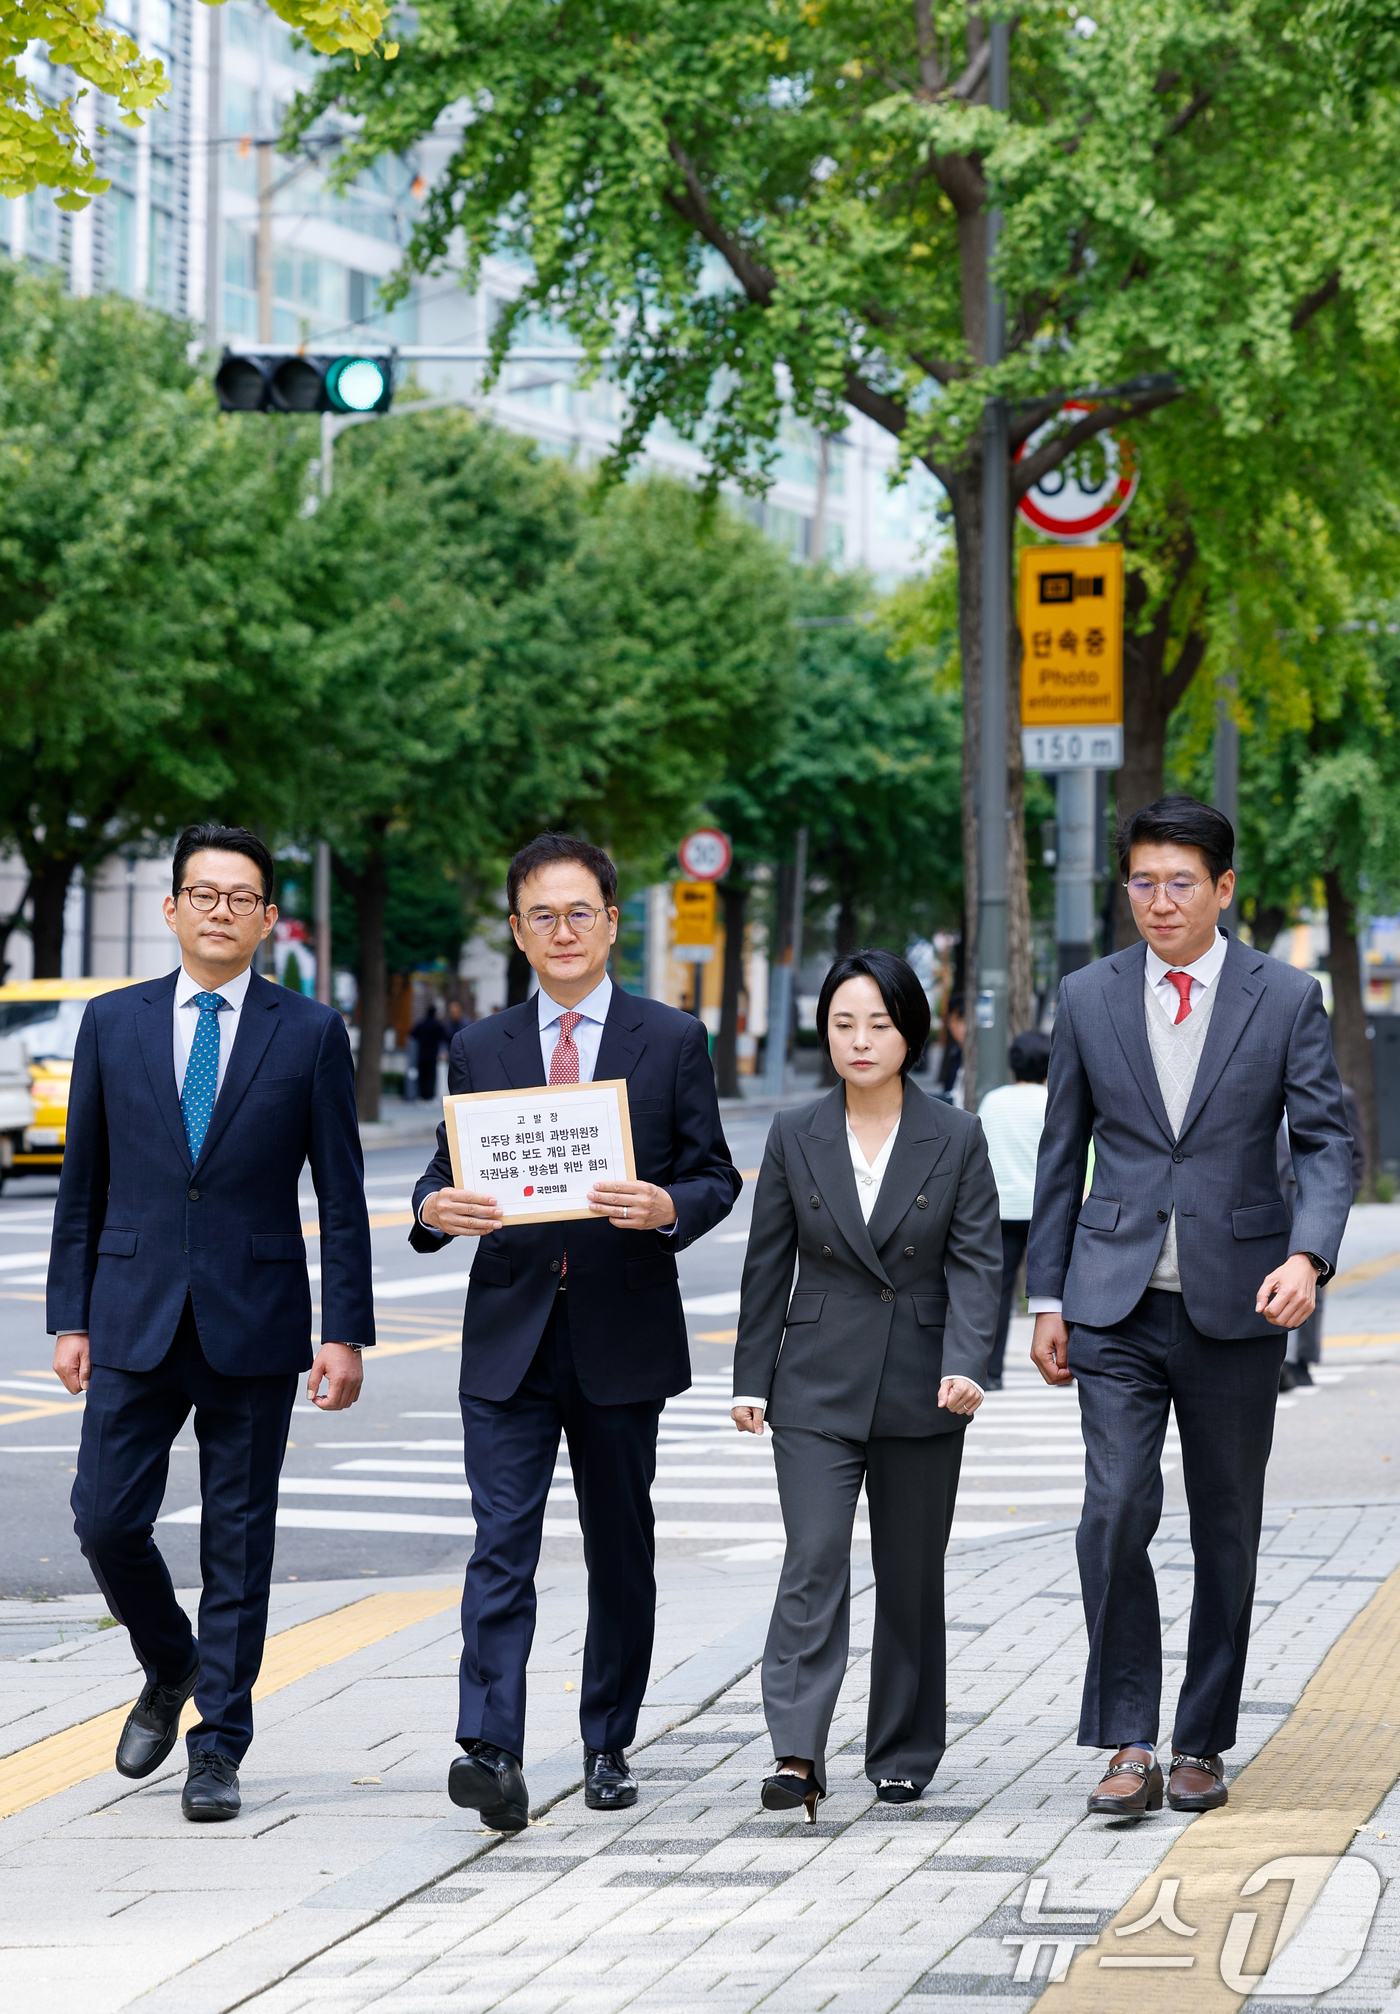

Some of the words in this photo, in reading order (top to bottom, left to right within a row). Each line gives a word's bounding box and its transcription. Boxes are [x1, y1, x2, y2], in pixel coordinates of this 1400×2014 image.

[1031, 627, 1106, 659] 단속중
[1038, 668, 1100, 687] Photo
[1035, 734, 1083, 760] 150
[1090, 738, 1113, 758] m
[480, 1133, 510, 1148] 민주당
[515, 1130, 545, 1145] 최민희
[550, 1125, 599, 1142] 과방위원장
[492, 1150, 517, 1162] MBC
[522, 1148, 542, 1160] 보도
[547, 1145, 566, 1158] 개입
[571, 1143, 591, 1156] 관련
[563, 1160, 583, 1173] 위반
[588, 1158, 608, 1171] 혐의
[536, 1183, 568, 1195] 국민의힘
